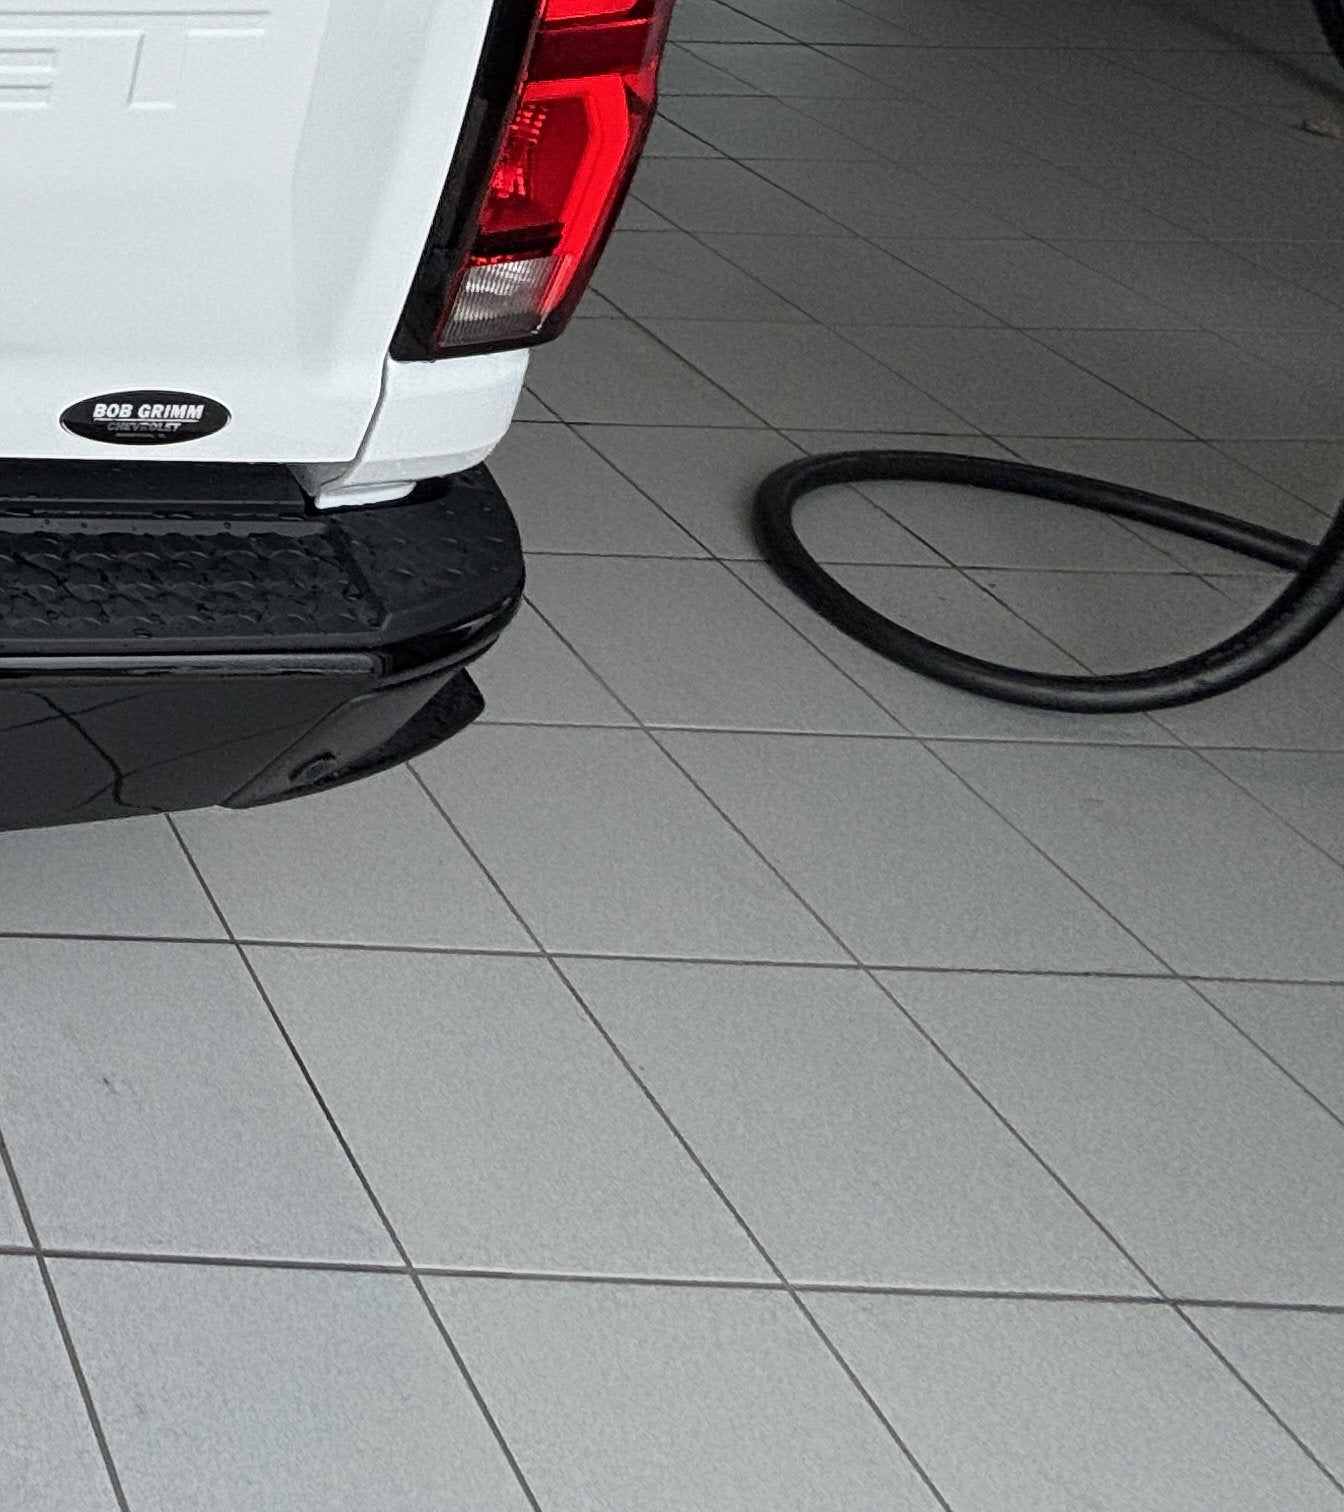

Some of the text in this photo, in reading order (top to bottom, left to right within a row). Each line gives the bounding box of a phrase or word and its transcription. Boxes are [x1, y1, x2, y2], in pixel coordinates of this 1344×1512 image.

[92, 403, 204, 420] BOB GRIMM
[107, 422, 181, 432] CHEVROLET
